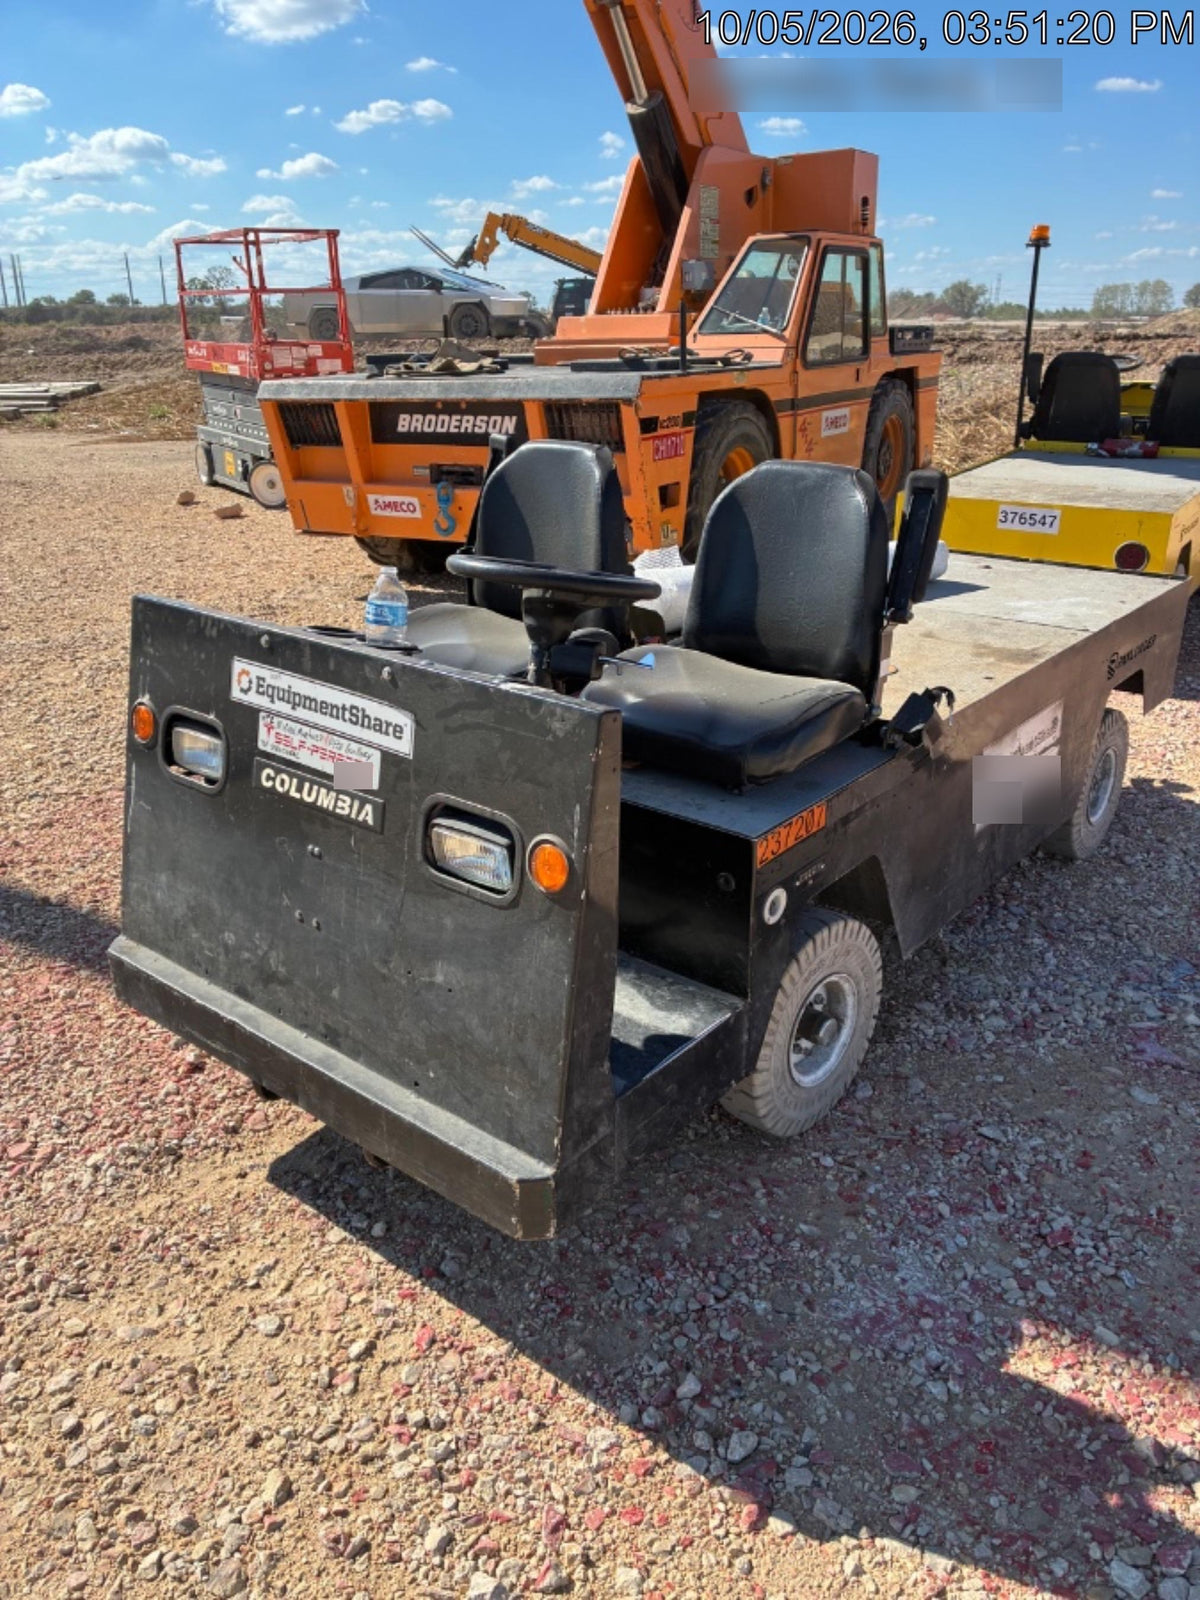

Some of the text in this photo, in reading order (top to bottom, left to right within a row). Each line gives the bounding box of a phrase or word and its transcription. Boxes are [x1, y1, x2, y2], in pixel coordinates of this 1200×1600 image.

[396, 413, 518, 434] BRODERSON
[374, 499, 417, 513] AMECO
[999, 509, 1057, 529] 376547
[255, 675, 404, 740] EquipmentShare
[260, 767, 374, 826] COLUMBIA
[759, 803, 825, 866] 237207
